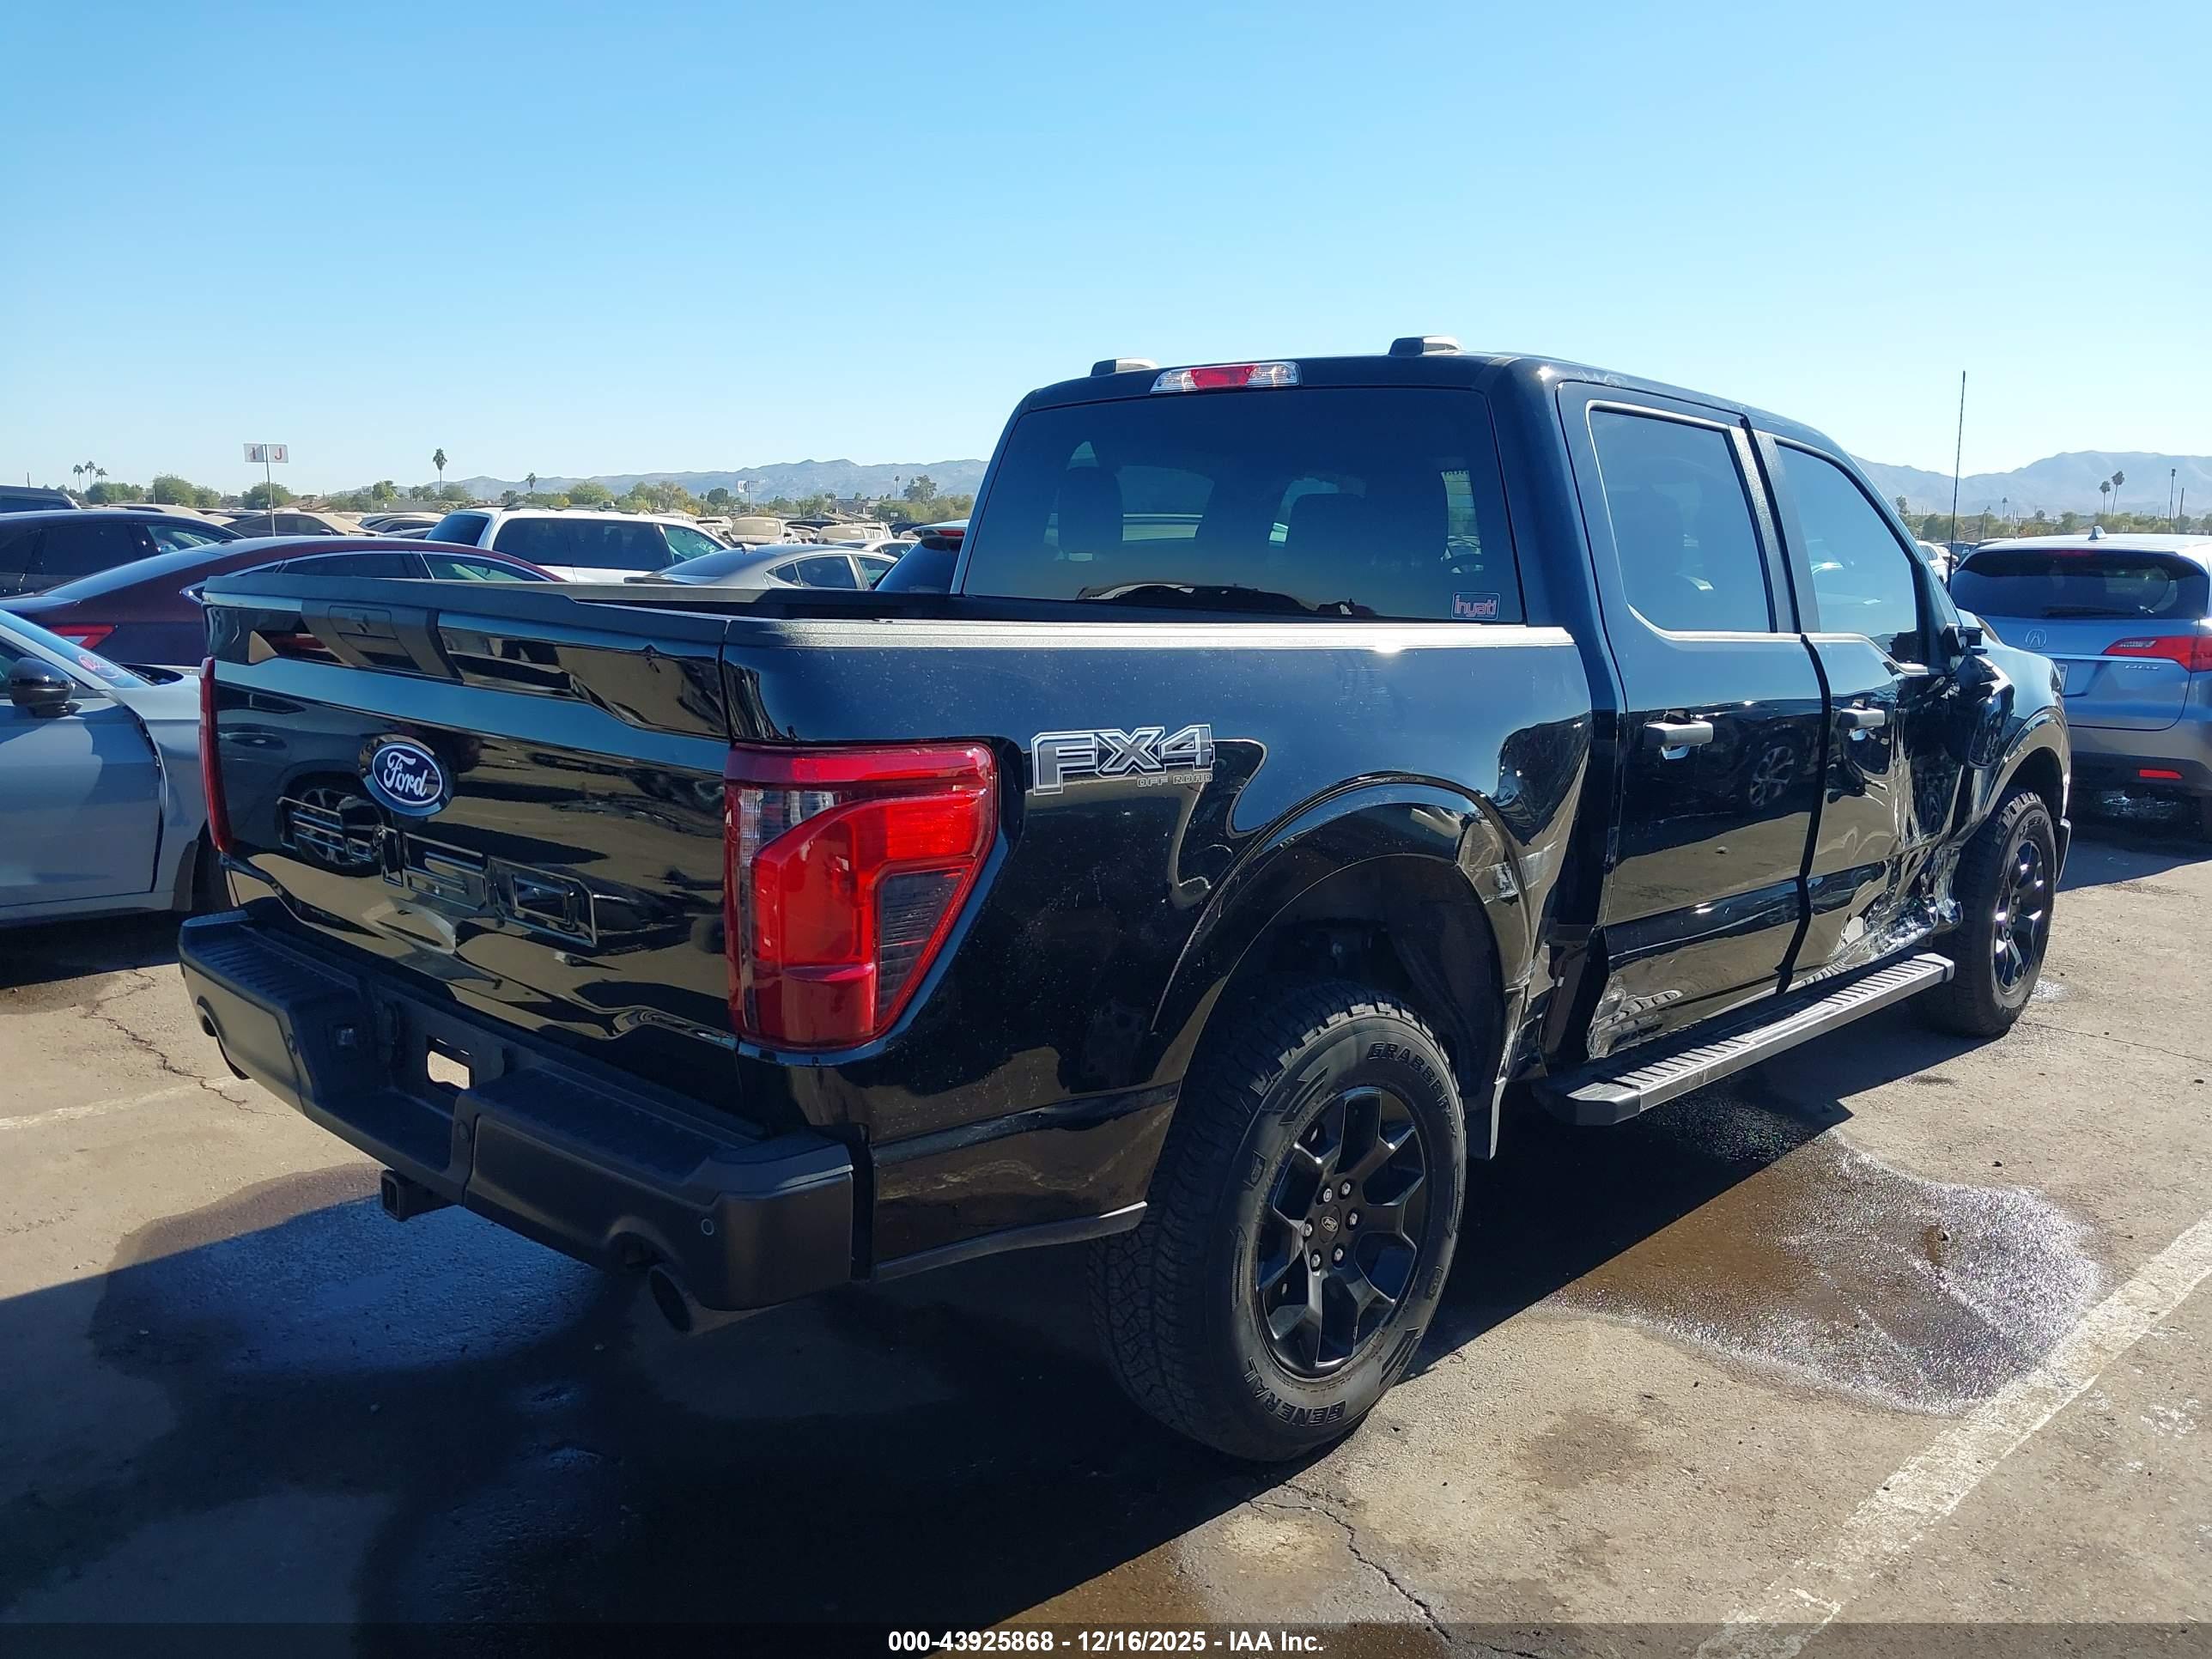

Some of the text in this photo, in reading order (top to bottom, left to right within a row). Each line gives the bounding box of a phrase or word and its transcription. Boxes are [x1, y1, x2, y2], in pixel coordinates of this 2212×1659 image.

[274, 447, 283, 460] J
[1454, 594, 1497, 617] inyati
[383, 750, 428, 798] Ford
[1030, 724, 1215, 796] FX4
[1136, 773, 1213, 788] OFF ROAD
[1367, 1041, 1452, 1115] GRABBER
[1244, 1356, 1347, 1427] GENERAL
